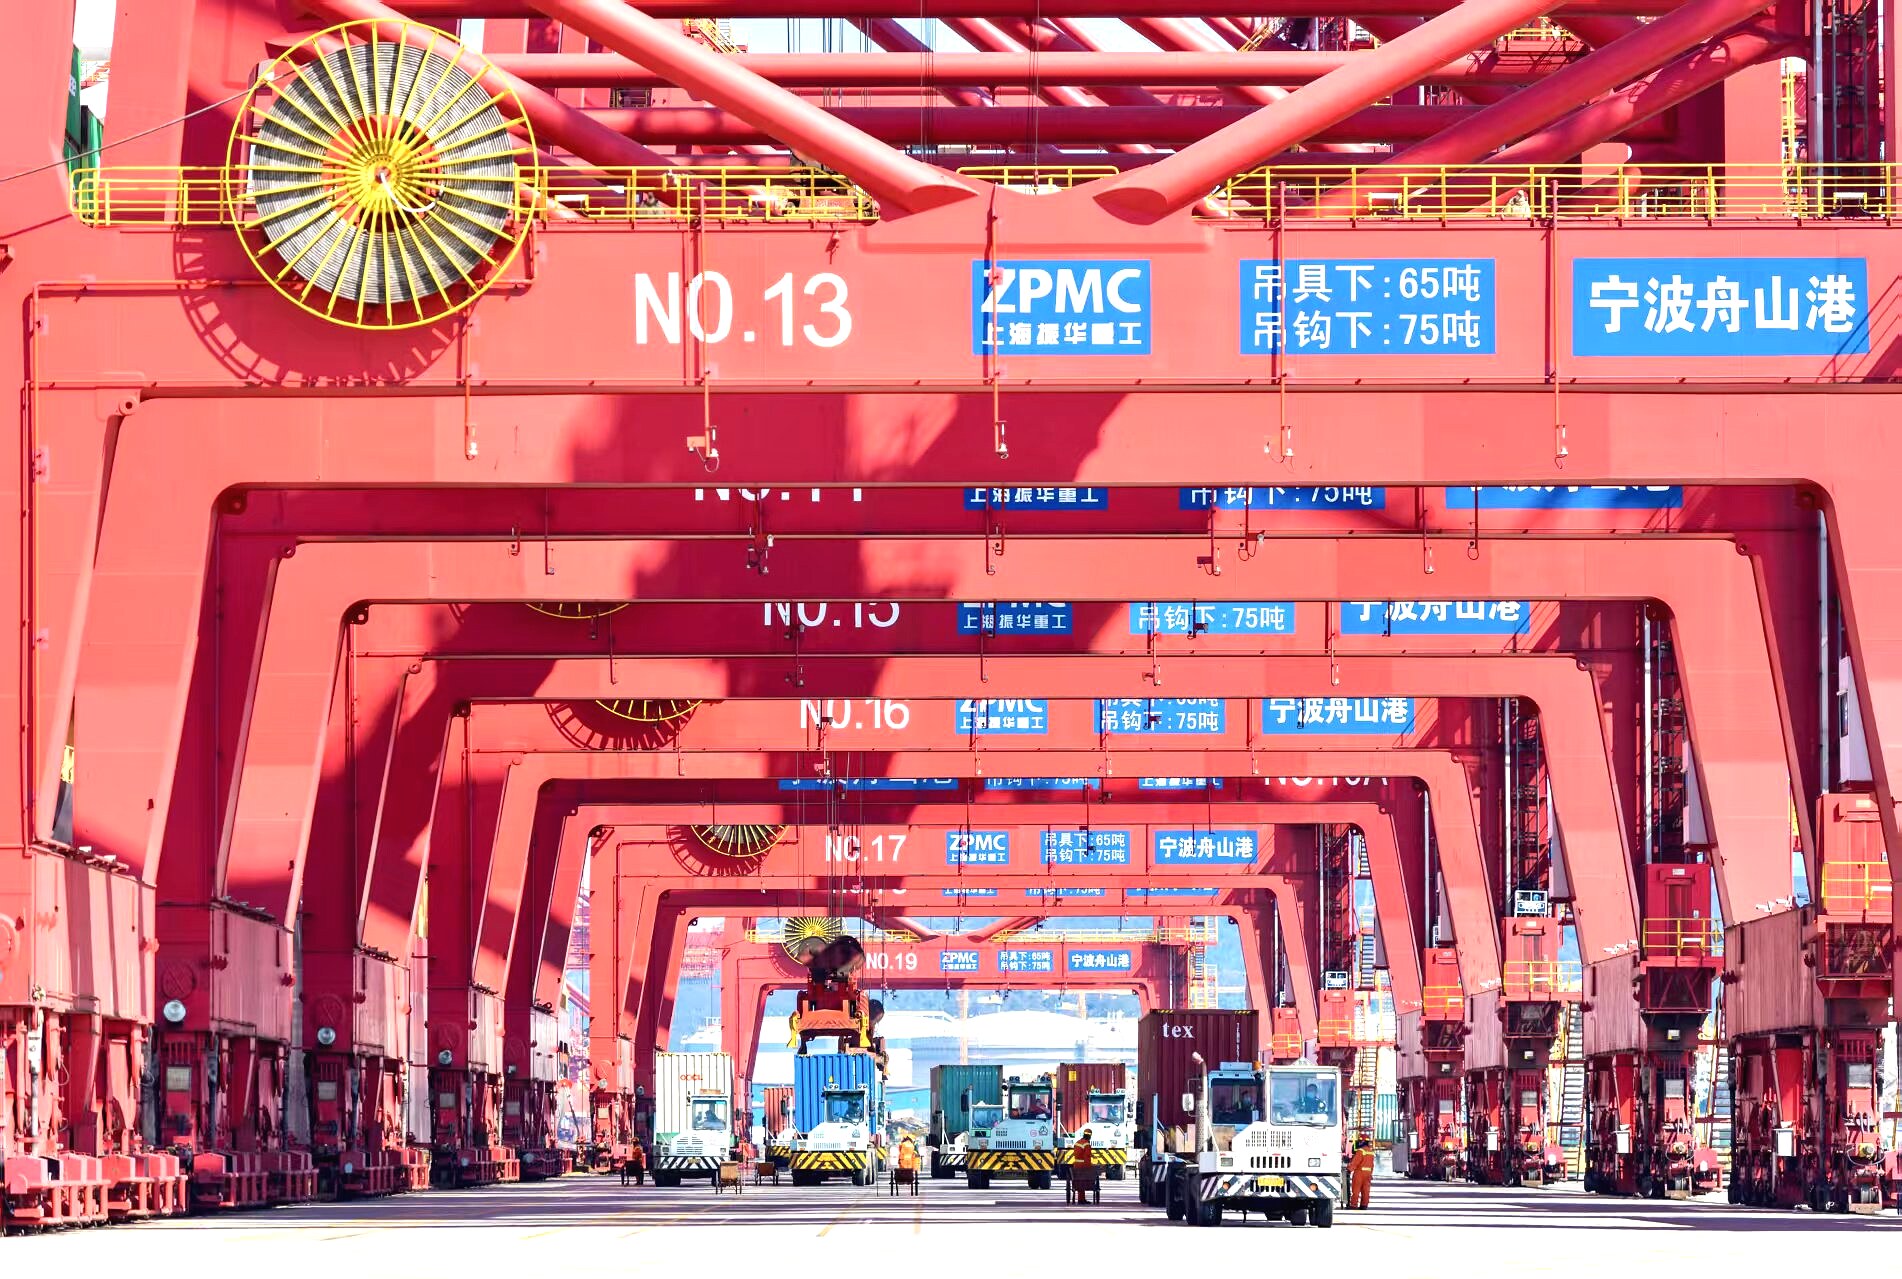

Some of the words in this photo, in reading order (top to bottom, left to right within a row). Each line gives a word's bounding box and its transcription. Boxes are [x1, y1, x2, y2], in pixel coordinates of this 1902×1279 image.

[981, 268, 1142, 315] ZPMC
[1253, 261, 1481, 303] 吊具下:65吨
[634, 270, 853, 348] NO.13
[1589, 275, 1857, 334] 宁波舟山港
[982, 321, 1142, 346] 上海振华重工
[1253, 310, 1481, 349] 吊钩下:75吨
[1139, 605, 1285, 631] 吊钩下:75吨
[1101, 710, 1219, 732] 吊钩下:75吨
[950, 834, 1006, 851] ZPMC
[1159, 836, 1253, 858] 宁波舟山港
[865, 952, 918, 971] NO.19
[1162, 1022, 1194, 1039] tex
